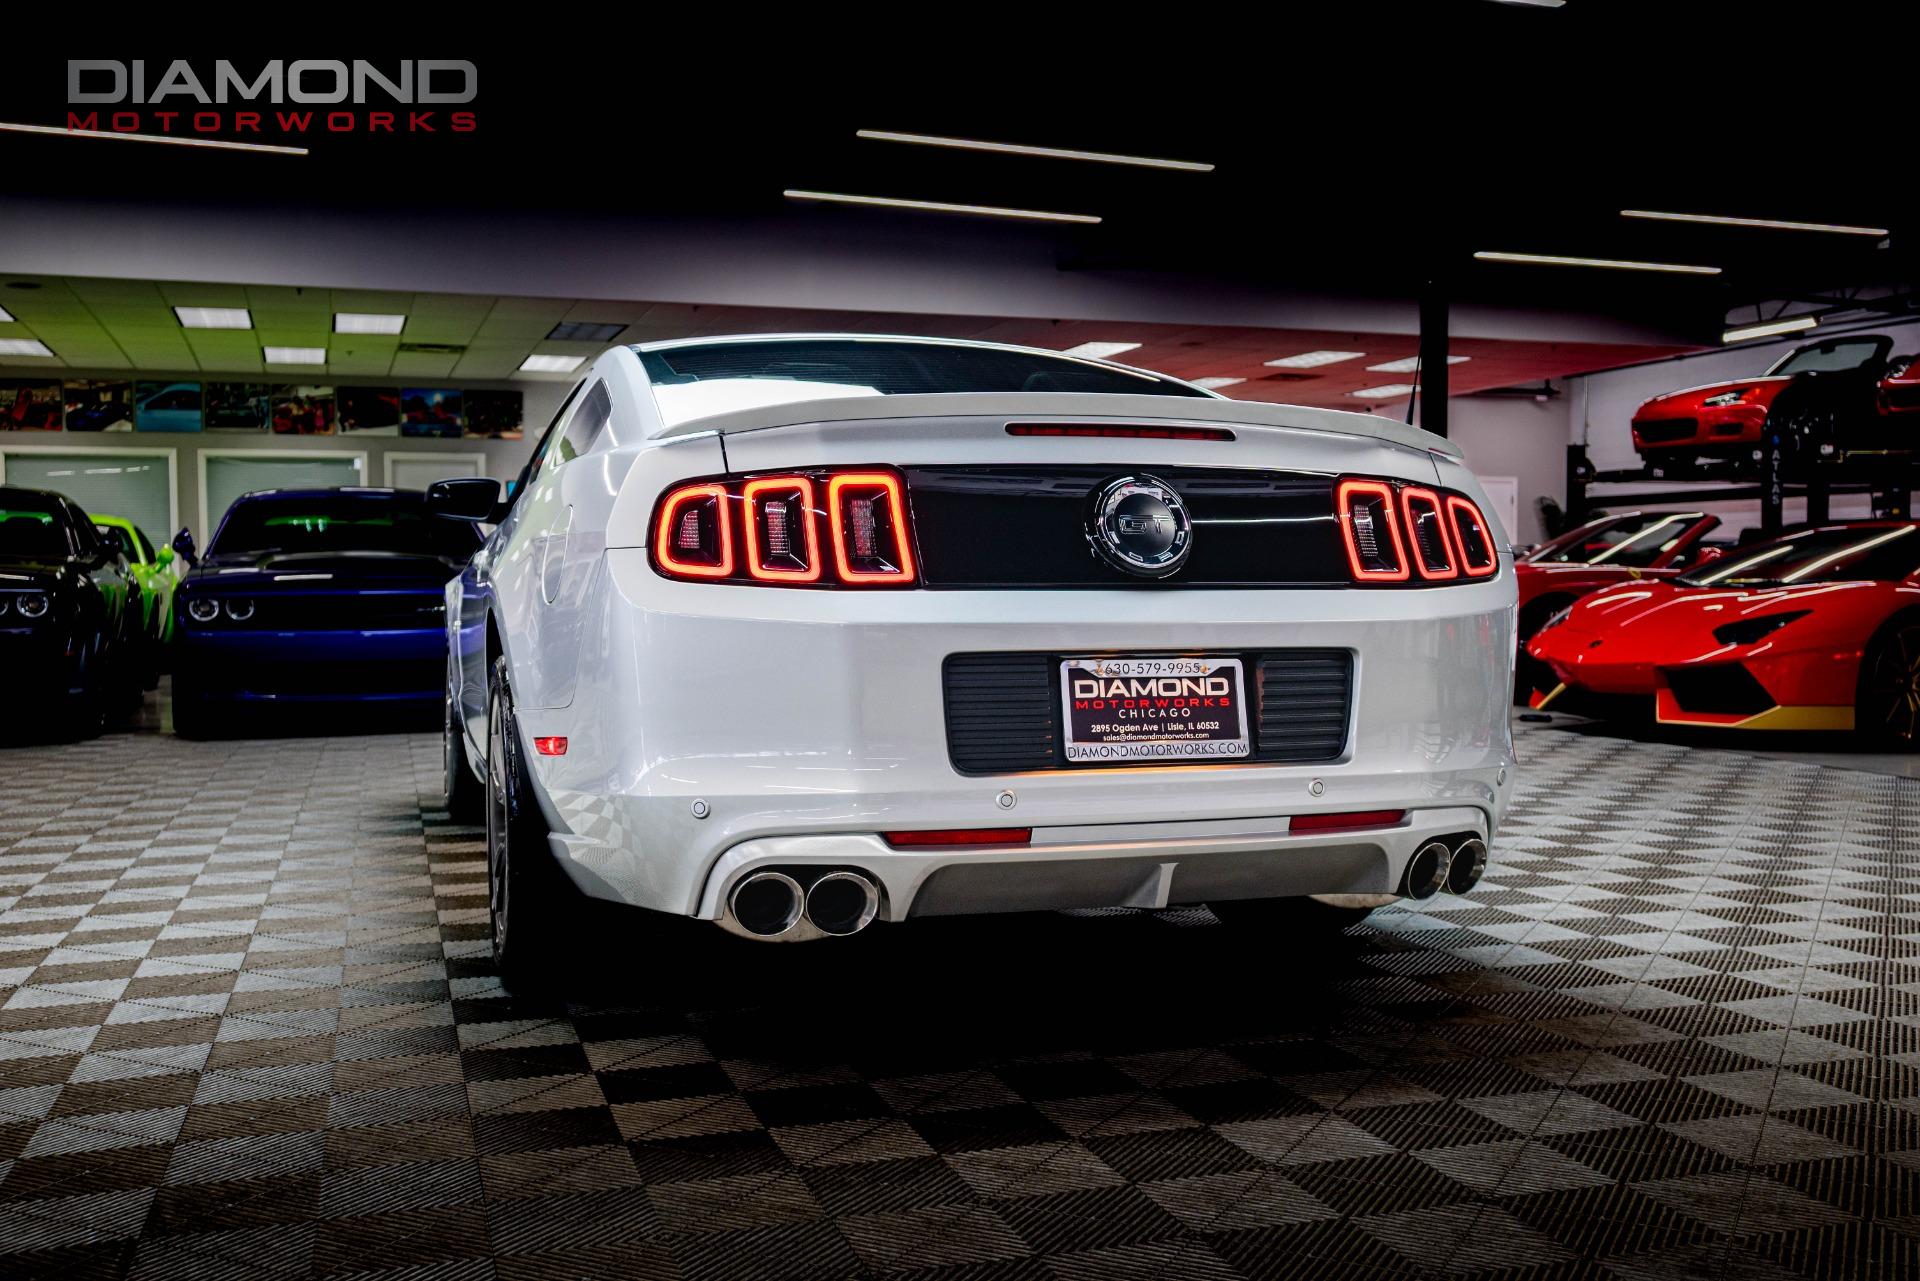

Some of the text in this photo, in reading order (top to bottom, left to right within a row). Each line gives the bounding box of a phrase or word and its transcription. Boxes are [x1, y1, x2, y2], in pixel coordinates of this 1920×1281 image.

[1771, 449, 1781, 505] ATLAS
[1119, 514, 1171, 535] GT
[1104, 662, 1200, 675] 630-579-9955
[1074, 677, 1230, 699] DIAMOND
[1075, 697, 1231, 710] MOTORWORKS
[1118, 707, 1191, 719] CHICAGO
[1091, 724, 1111, 733] 2895
[1112, 723, 1141, 734] Ogden
[1142, 723, 1159, 731] Ave
[1188, 722, 1195, 730] IL
[1196, 721, 1220, 730] 60532
[1103, 732, 1210, 741] sales@diamondmotorworks.com
[1067, 742, 1249, 759] DIAMONDMOTORWORKS.COM
